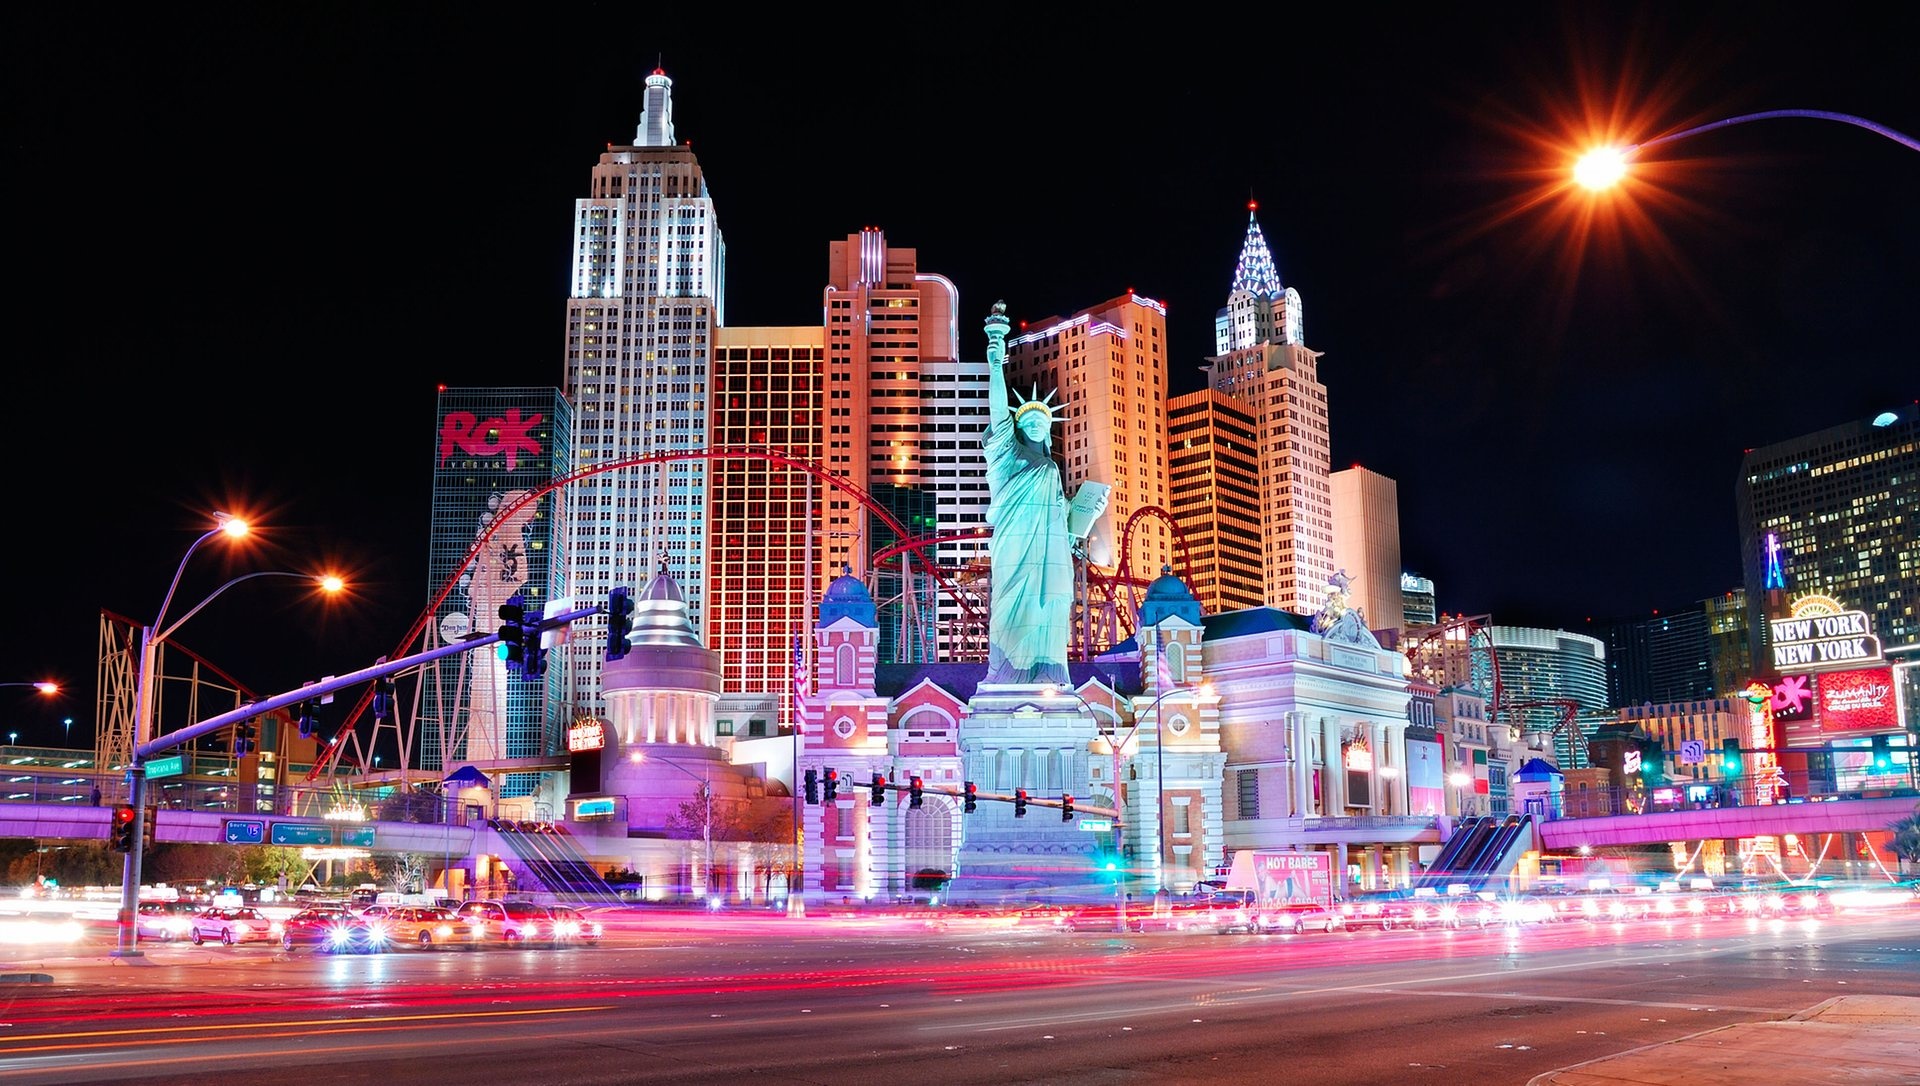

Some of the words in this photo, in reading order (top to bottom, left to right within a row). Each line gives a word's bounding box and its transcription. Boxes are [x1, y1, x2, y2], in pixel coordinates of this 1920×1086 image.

[439, 408, 543, 473] ROK
[1772, 619, 1812, 642] NEW
[1814, 614, 1865, 637] YORK
[1774, 643, 1814, 666] NEW
[1816, 638, 1867, 661] YORK
[1826, 684, 1889, 700] ZUMANITY
[146, 764, 169, 774] Tropicana
[170, 761, 180, 770] Ave
[249, 827, 258, 836] 15
[1266, 856, 1286, 869] HOT
[1288, 856, 1318, 869] BABES
